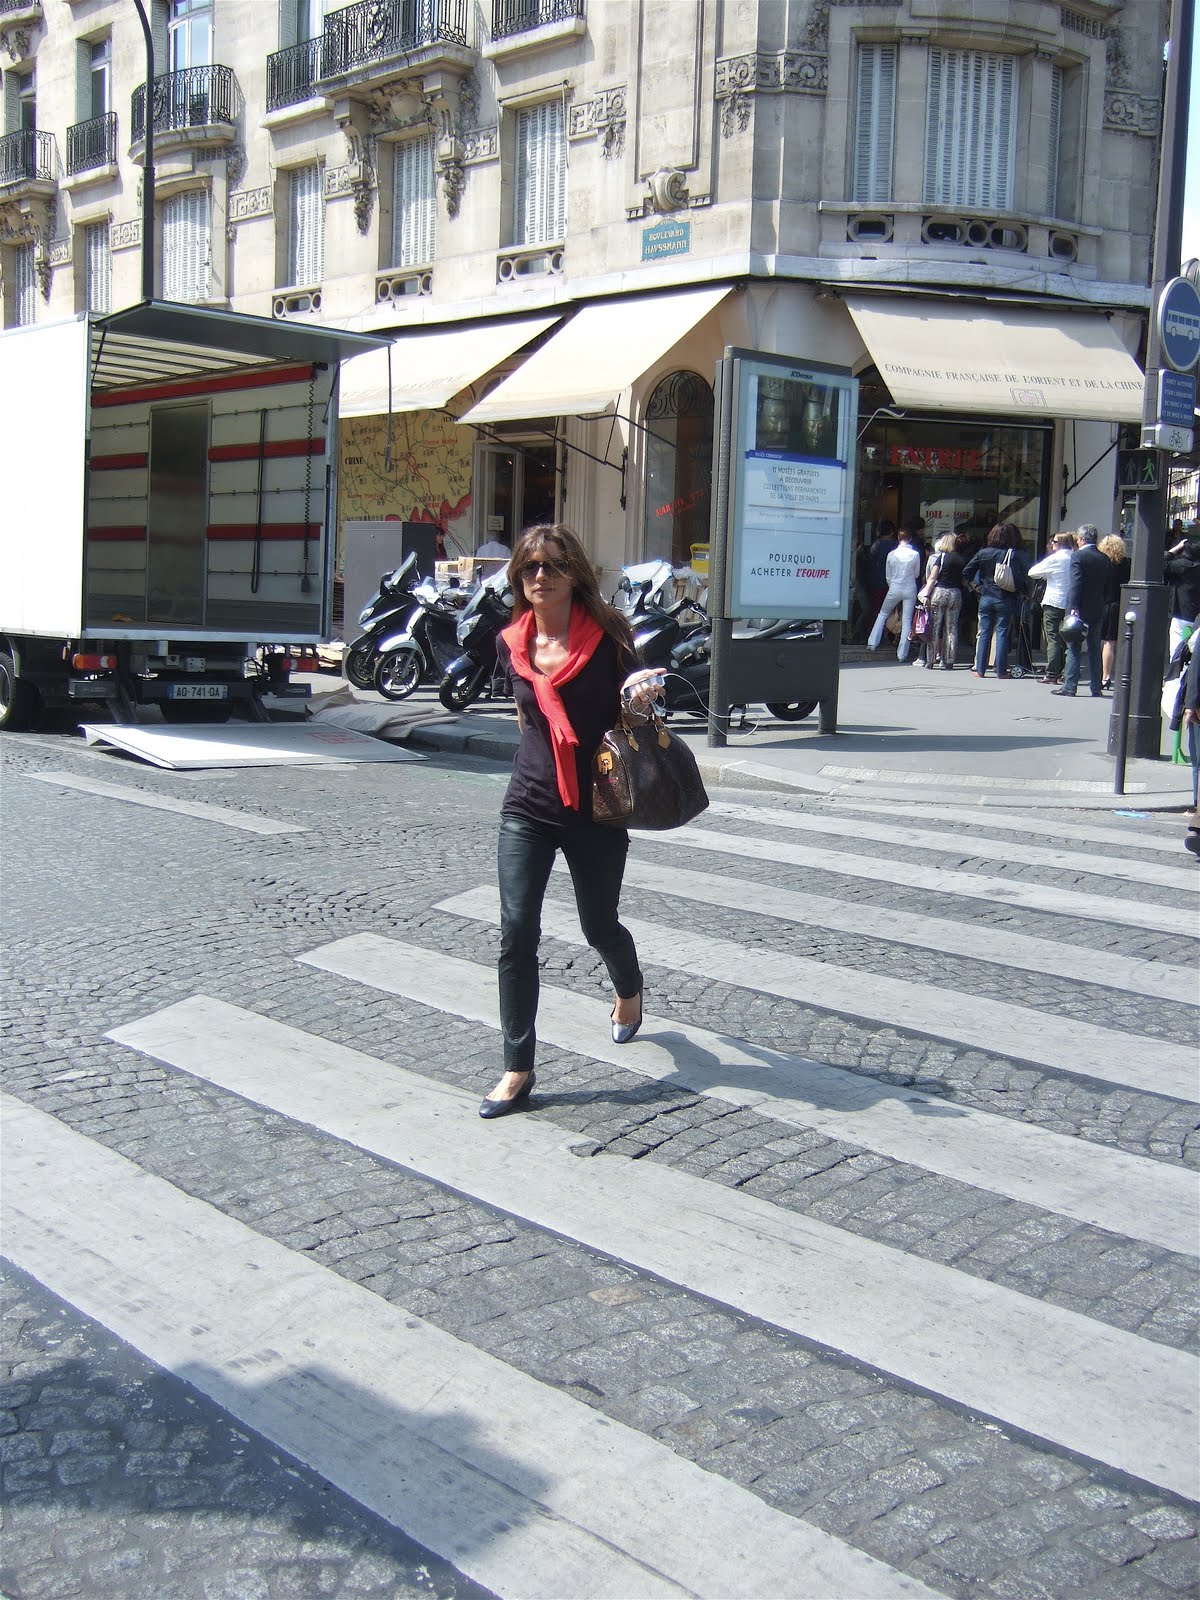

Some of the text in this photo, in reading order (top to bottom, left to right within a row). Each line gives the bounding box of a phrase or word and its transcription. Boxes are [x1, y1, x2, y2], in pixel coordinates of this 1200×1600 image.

[884, 363, 942, 379] COMPAGNIE
[946, 372, 1002, 384] FRANÇAISE
[1005, 374, 1020, 383] DE
[1023, 375, 1067, 386] L'ORIENT
[1070, 378, 1082, 388] ET
[1084, 380, 1099, 388] DE
[1100, 380, 1114, 390] LA
[797, 470, 820, 478] GRATUITS
[764, 483, 827, 495] COLLECTIONS PERMANENTES
[769, 553, 816, 565] POURQUOI
[751, 567, 792, 577] ACHETER
